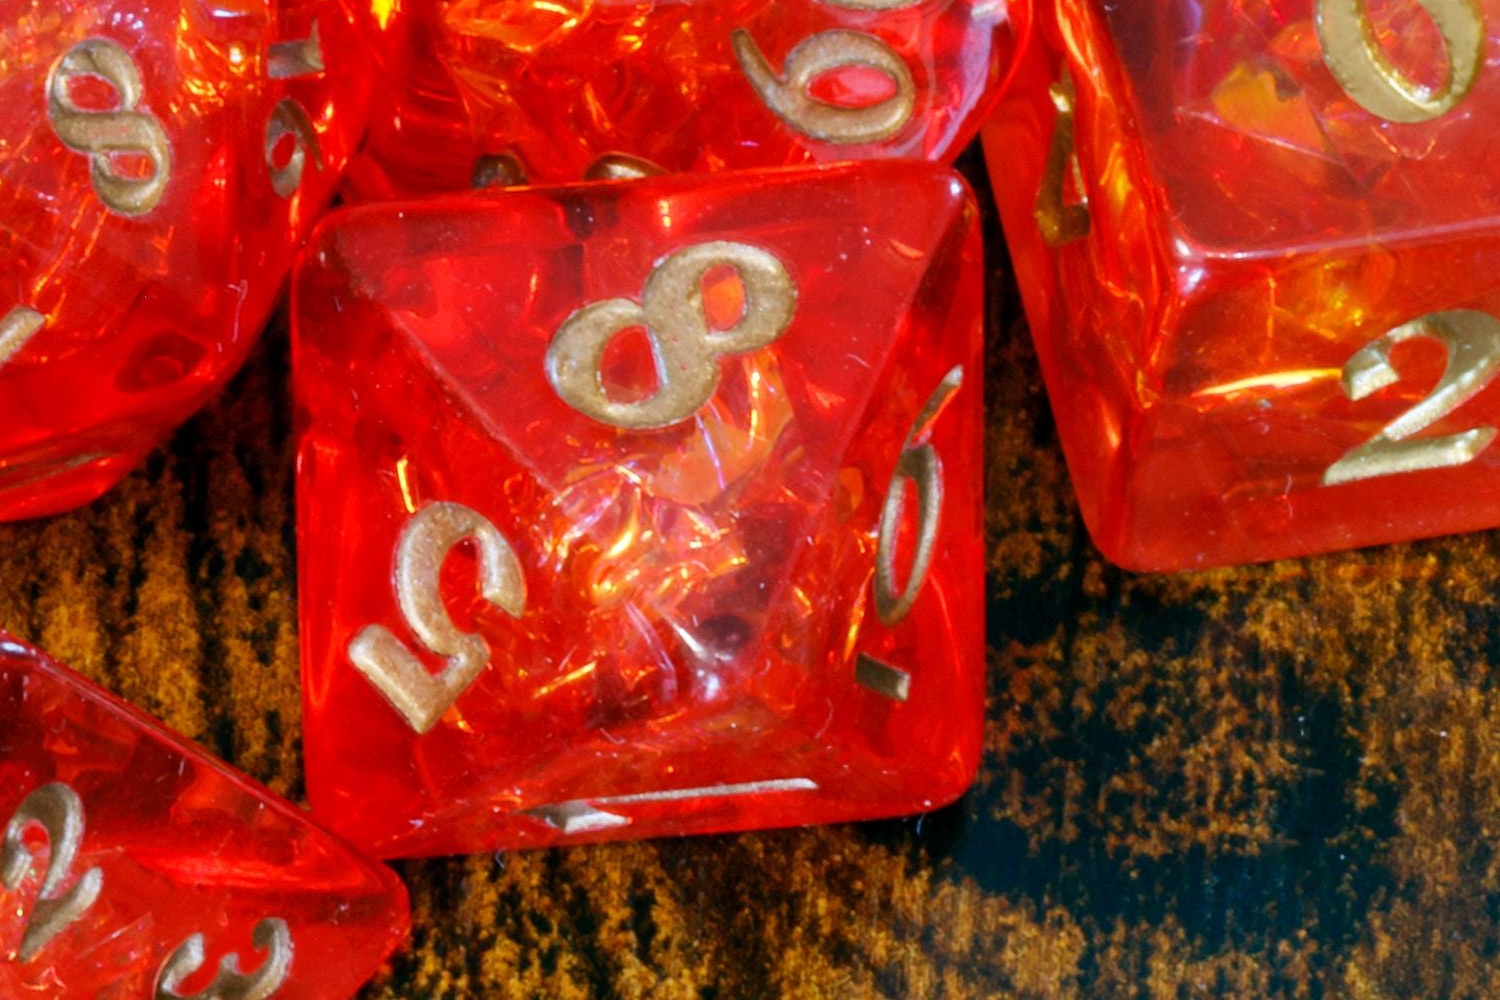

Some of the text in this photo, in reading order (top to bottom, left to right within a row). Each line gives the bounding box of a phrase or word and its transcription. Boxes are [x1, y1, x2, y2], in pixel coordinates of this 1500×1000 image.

[46, 37, 171, 218] 8
[545, 240, 798, 430] 8
[1322, 308, 1500, 485] 2
[348, 501, 527, 735] 5
[0, 782, 103, 964] 2
